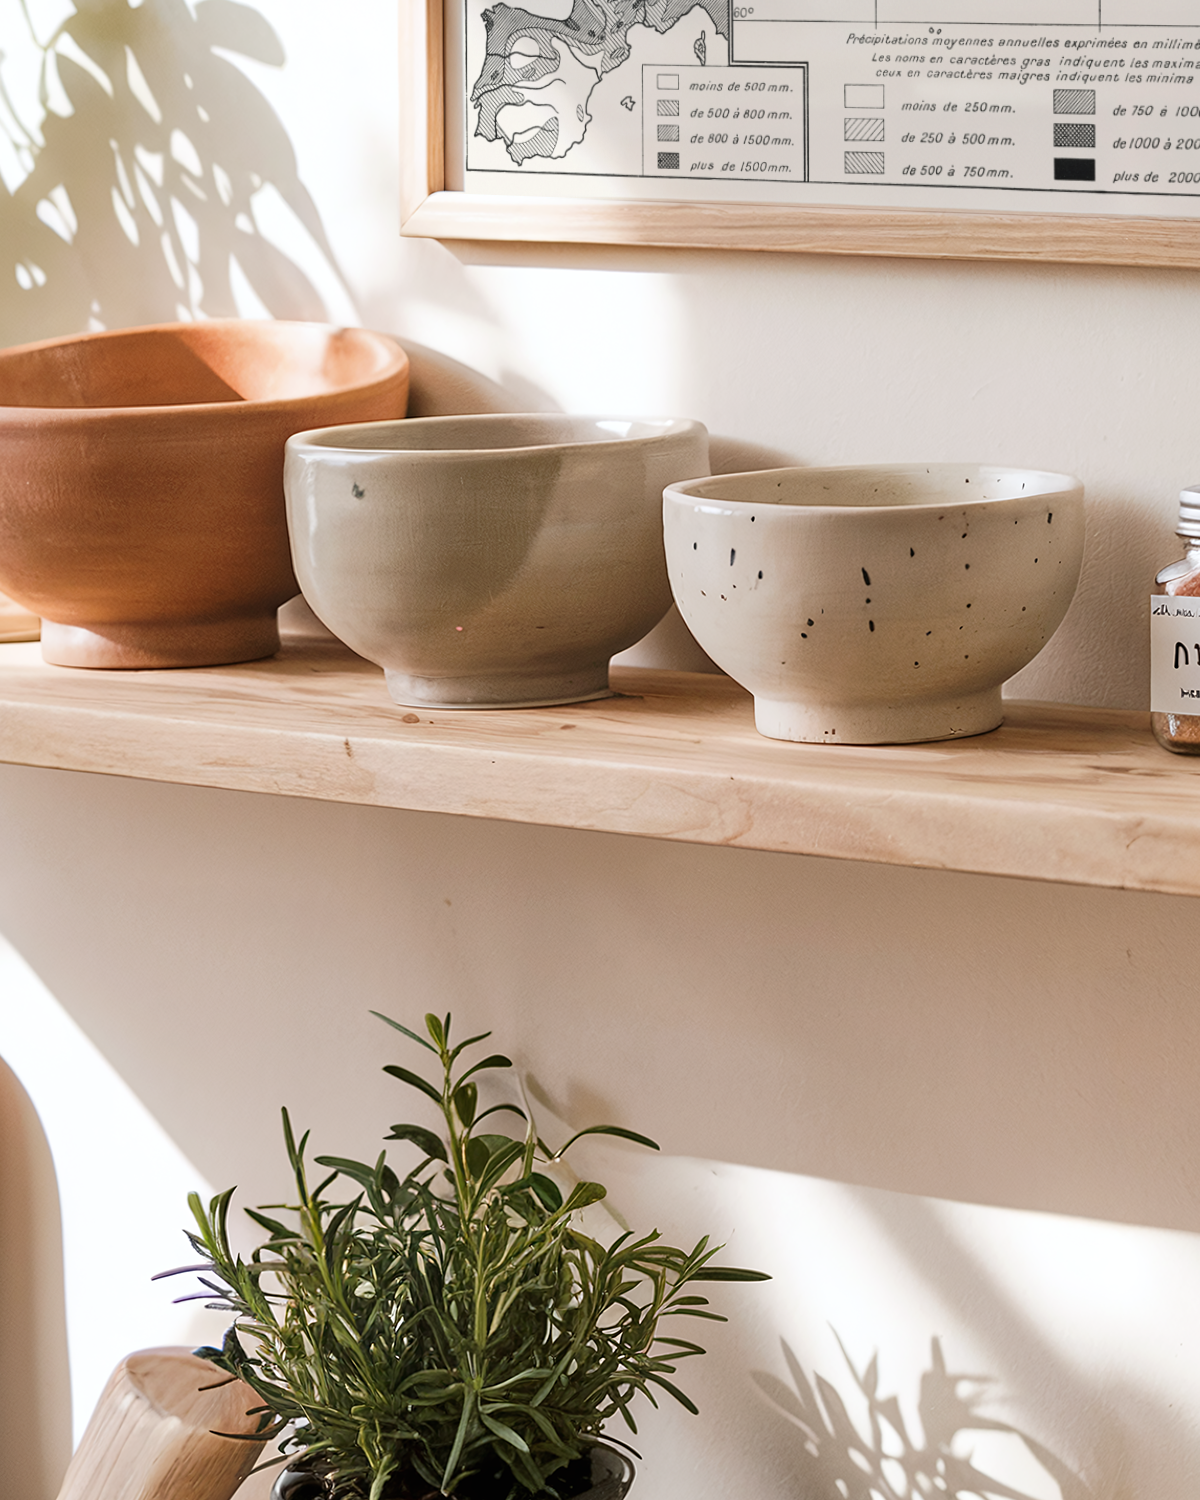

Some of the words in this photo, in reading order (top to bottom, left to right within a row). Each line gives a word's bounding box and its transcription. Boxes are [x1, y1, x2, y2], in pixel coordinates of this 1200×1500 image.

[846, 32, 928, 48] Précipitations
[933, 36, 994, 49] moyennes
[998, 36, 1059, 49] annuelles
[1064, 37, 1128, 51] exprimées
[1133, 40, 1148, 49] en
[871, 53, 891, 65] Les
[895, 55, 925, 65] noms
[929, 56, 945, 65] en
[949, 55, 1017, 67] caractères
[1021, 58, 1051, 70] gras
[1058, 55, 1125, 70] indiquent
[1130, 57, 1149, 69] les
[875, 68, 902, 78] ceux
[907, 69, 921, 78] en
[926, 67, 993, 81] caractères
[998, 69, 1050, 84] maigres
[1056, 69, 1119, 84] indiquent
[1124, 70, 1143, 83] les
[1145, 72, 1194, 84] minima
[689, 81, 724, 92] moins
[727, 82, 741, 92] de
[743, 82, 766, 93] 500
[690, 108, 704, 119] de
[707, 108, 730, 119] 500
[743, 109, 765, 120] 800
[901, 101, 937, 113] moins
[943, 101, 958, 113] de
[964, 102, 988, 113] 250
[1112, 104, 1126, 116] de
[1131, 105, 1154, 117] 750
[901, 132, 915, 144] de
[920, 133, 944, 145] 250
[961, 134, 986, 146] 500
[1112, 170, 1139, 184] plus
[1144, 171, 1159, 183] de
[1168, 172, 1200, 184] 2000
